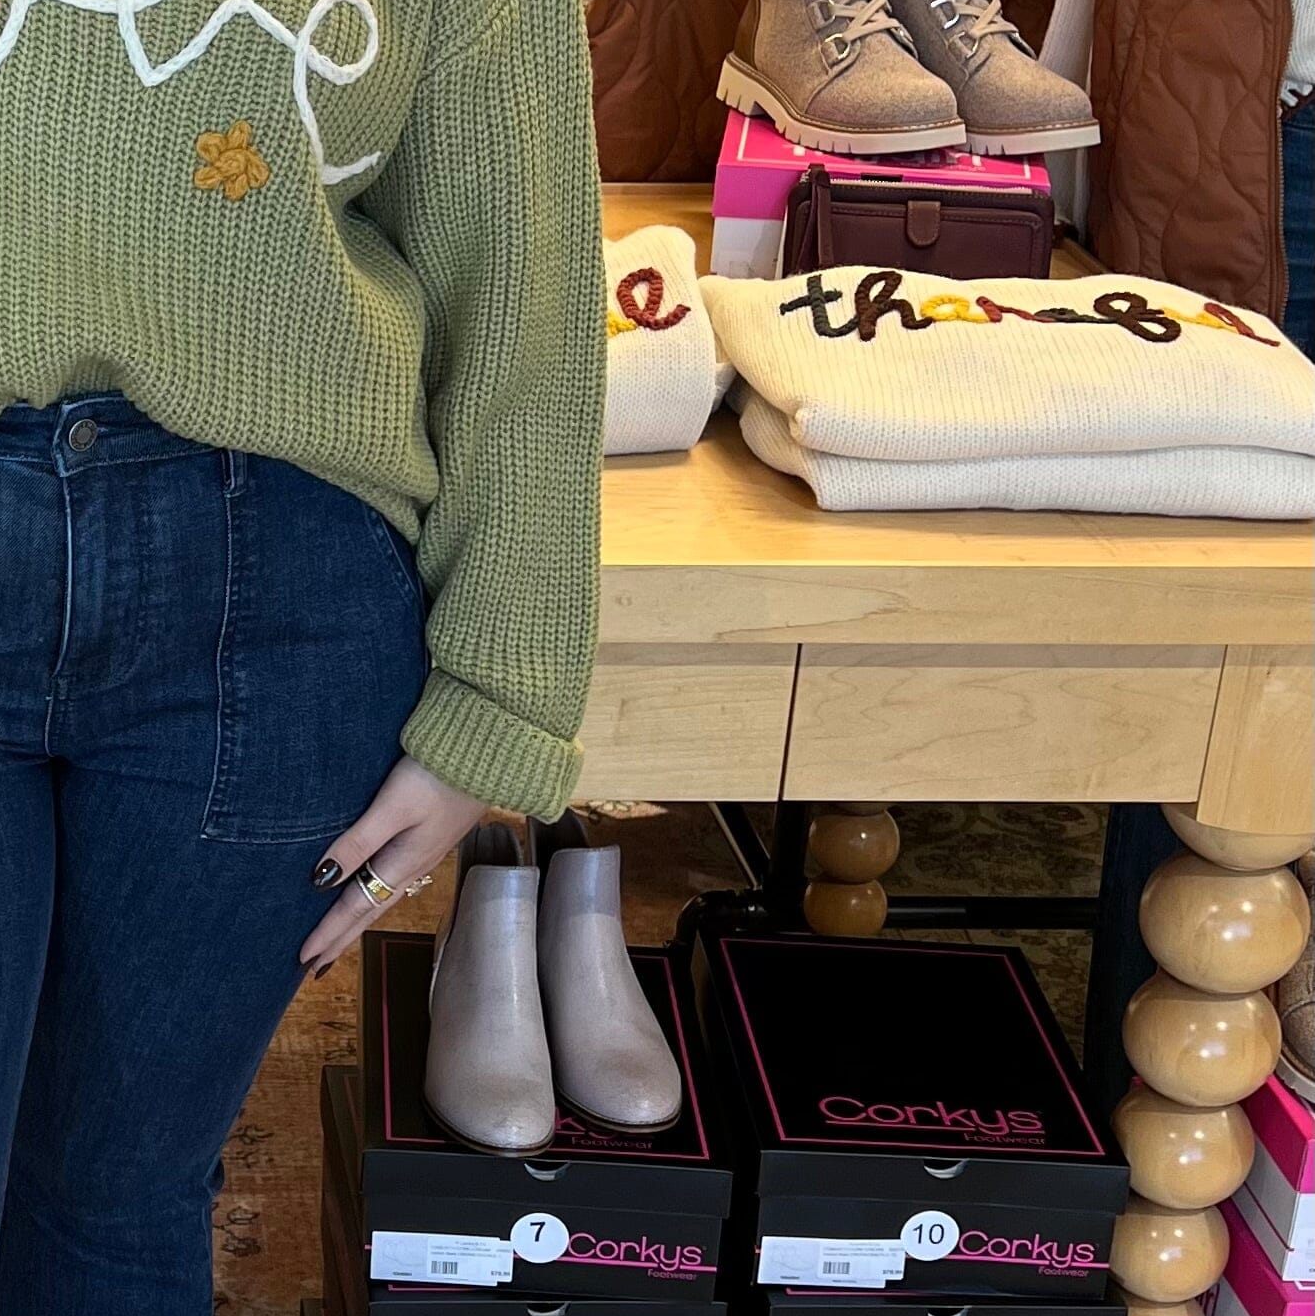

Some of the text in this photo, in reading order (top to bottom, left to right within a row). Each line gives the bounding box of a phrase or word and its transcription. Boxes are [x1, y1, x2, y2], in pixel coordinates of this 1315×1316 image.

[819, 1096, 1045, 1136] Corkys
[571, 1135, 653, 1150] Footwear
[964, 1133, 1047, 1145] Footwear
[529, 1221, 547, 1242] 7
[912, 1222, 945, 1246] 10
[568, 1232, 702, 1270] Corkys
[958, 1230, 1095, 1267] Corkys
[647, 1268, 697, 1280] Footwear
[1038, 1265, 1090, 1277] Footwear
